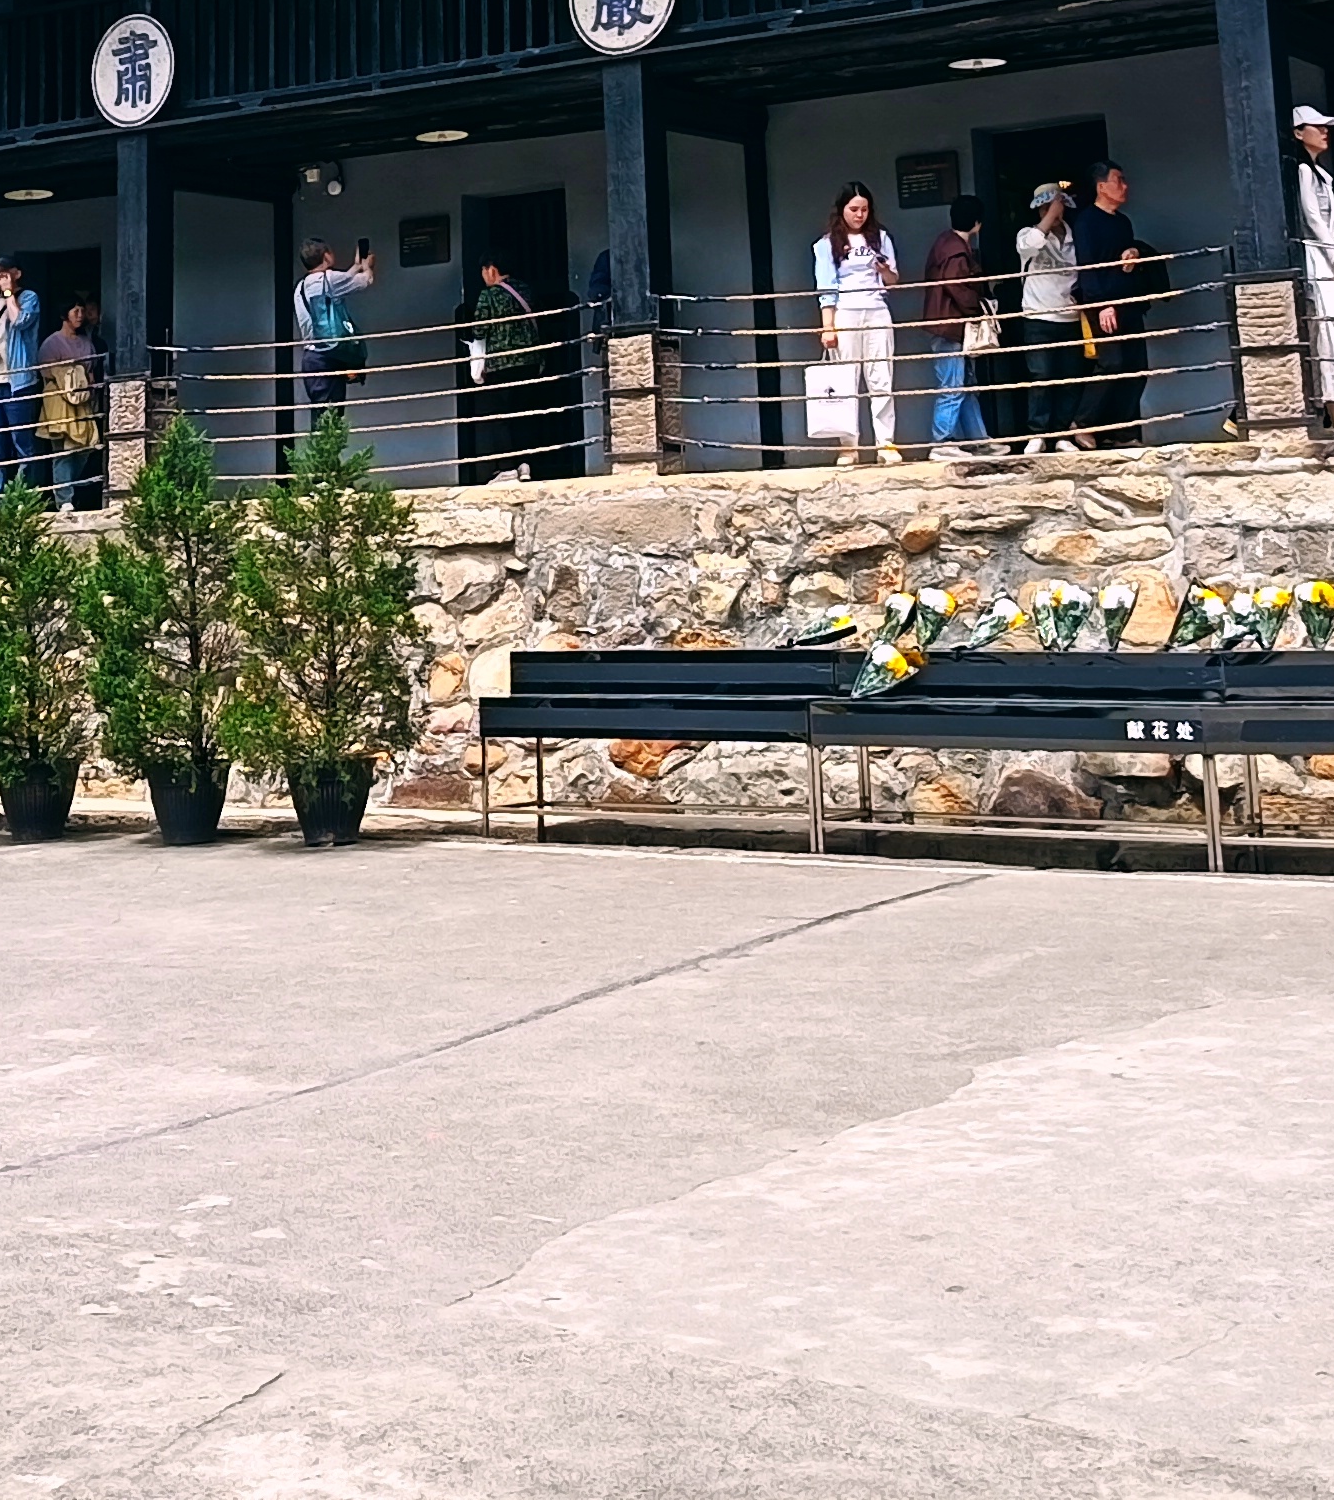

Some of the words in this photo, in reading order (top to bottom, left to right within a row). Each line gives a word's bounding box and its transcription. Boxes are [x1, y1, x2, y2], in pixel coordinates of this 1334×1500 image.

[111, 29, 158, 108] 肅
[1126, 720, 1195, 741] 献花处
